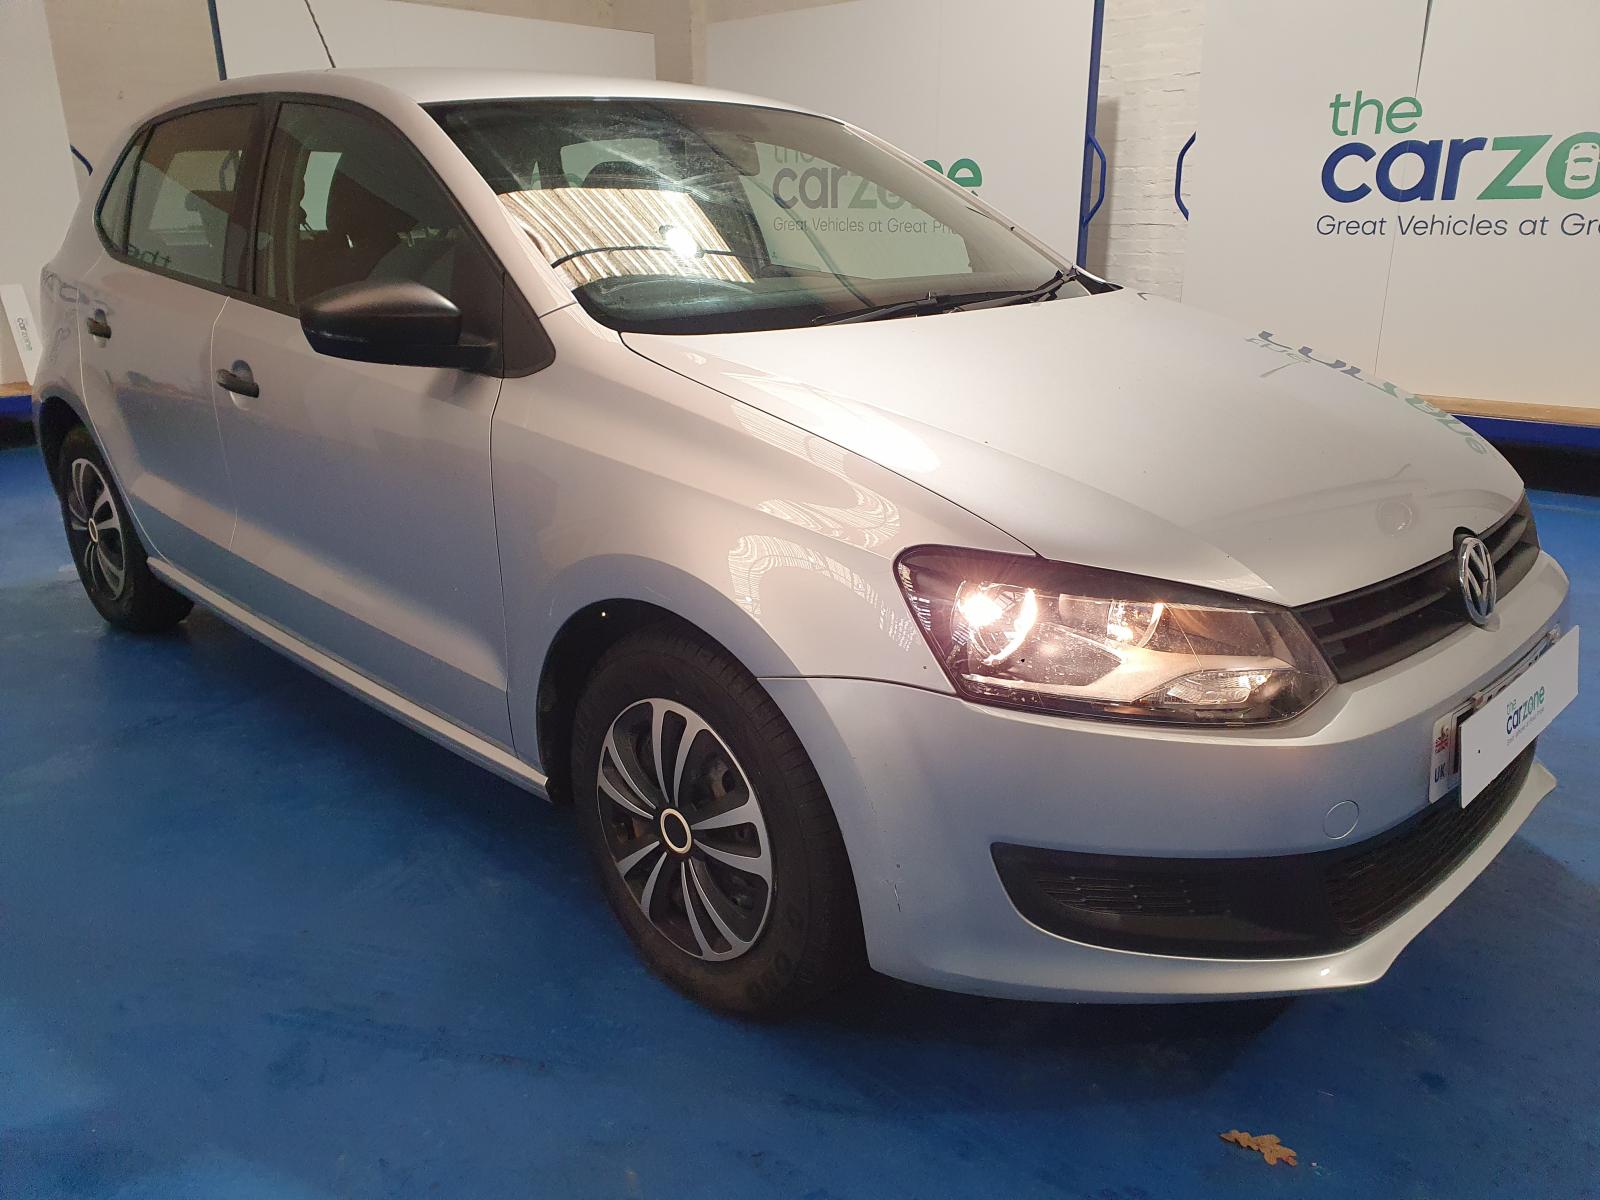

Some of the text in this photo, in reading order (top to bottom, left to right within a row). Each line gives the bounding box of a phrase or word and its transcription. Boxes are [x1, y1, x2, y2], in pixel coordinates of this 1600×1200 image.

[1329, 90, 1423, 136] the
[773, 216, 807, 232] Great
[812, 216, 865, 232] Vehicles
[868, 220, 883, 233] at
[887, 217, 927, 234] Great
[1316, 212, 1600, 236] Great Vehicles at Gr
[1506, 685, 1545, 735] carzone
[1434, 761, 1446, 783] UK
